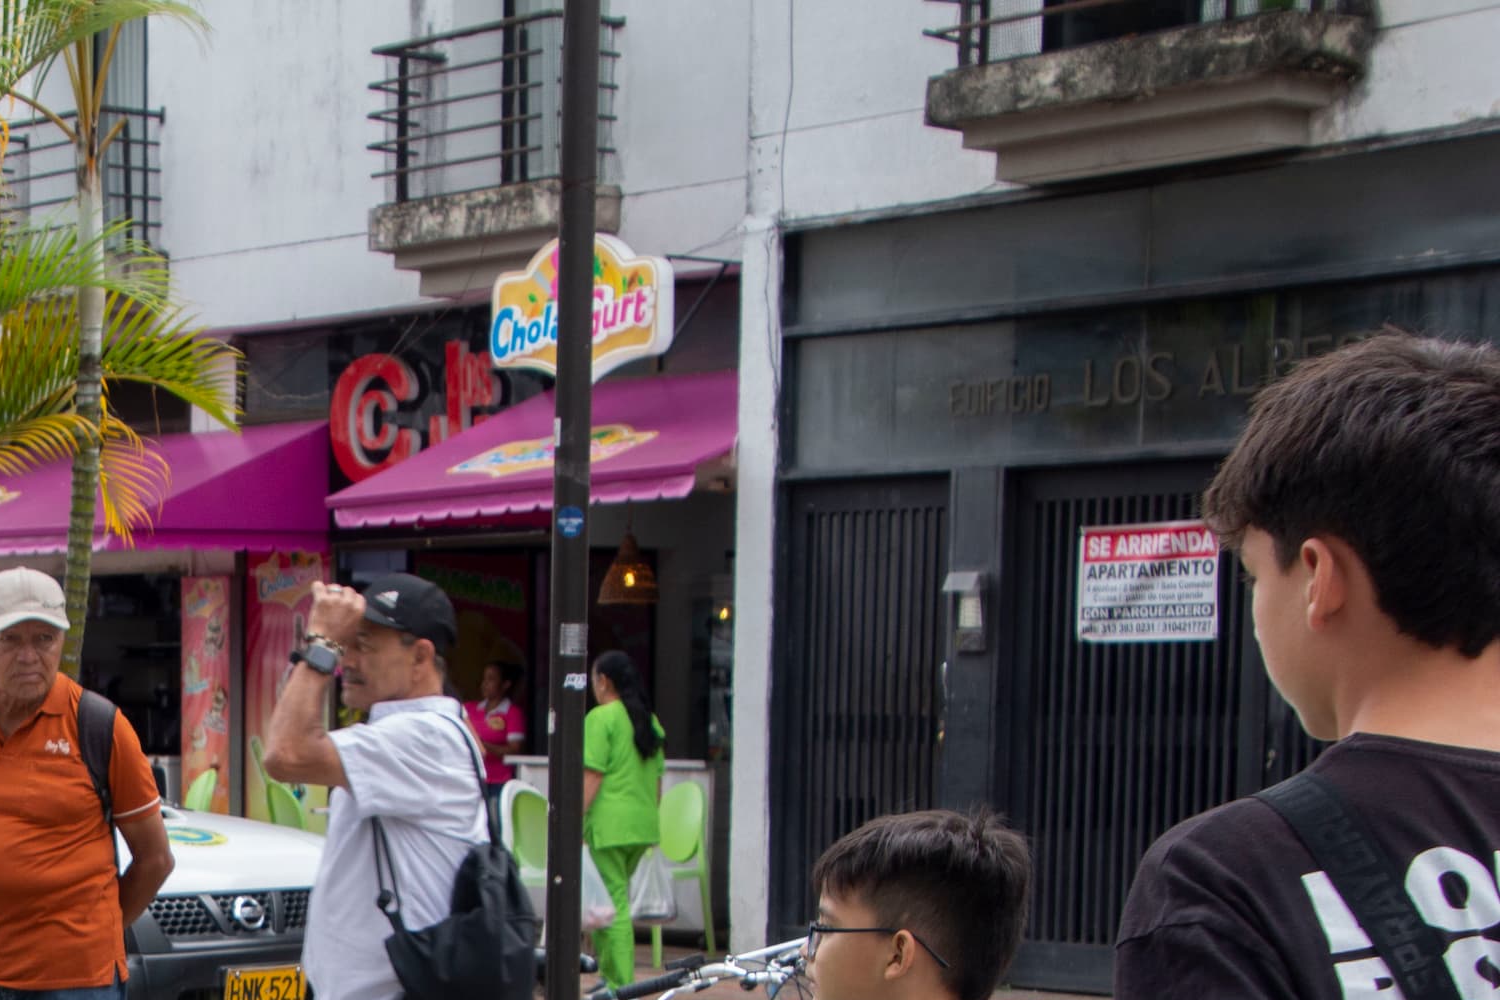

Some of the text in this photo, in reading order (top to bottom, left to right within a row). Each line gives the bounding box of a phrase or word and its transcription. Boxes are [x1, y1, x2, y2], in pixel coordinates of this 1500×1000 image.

[950, 372, 1051, 416] EDIFICIO
[1083, 351, 1176, 408] LOS
[1088, 530, 1215, 559] SE ARRIENDA
[1087, 559, 1215, 579] APARTAMENTO
[1083, 603, 1212, 619] CON PARQUEADERO
